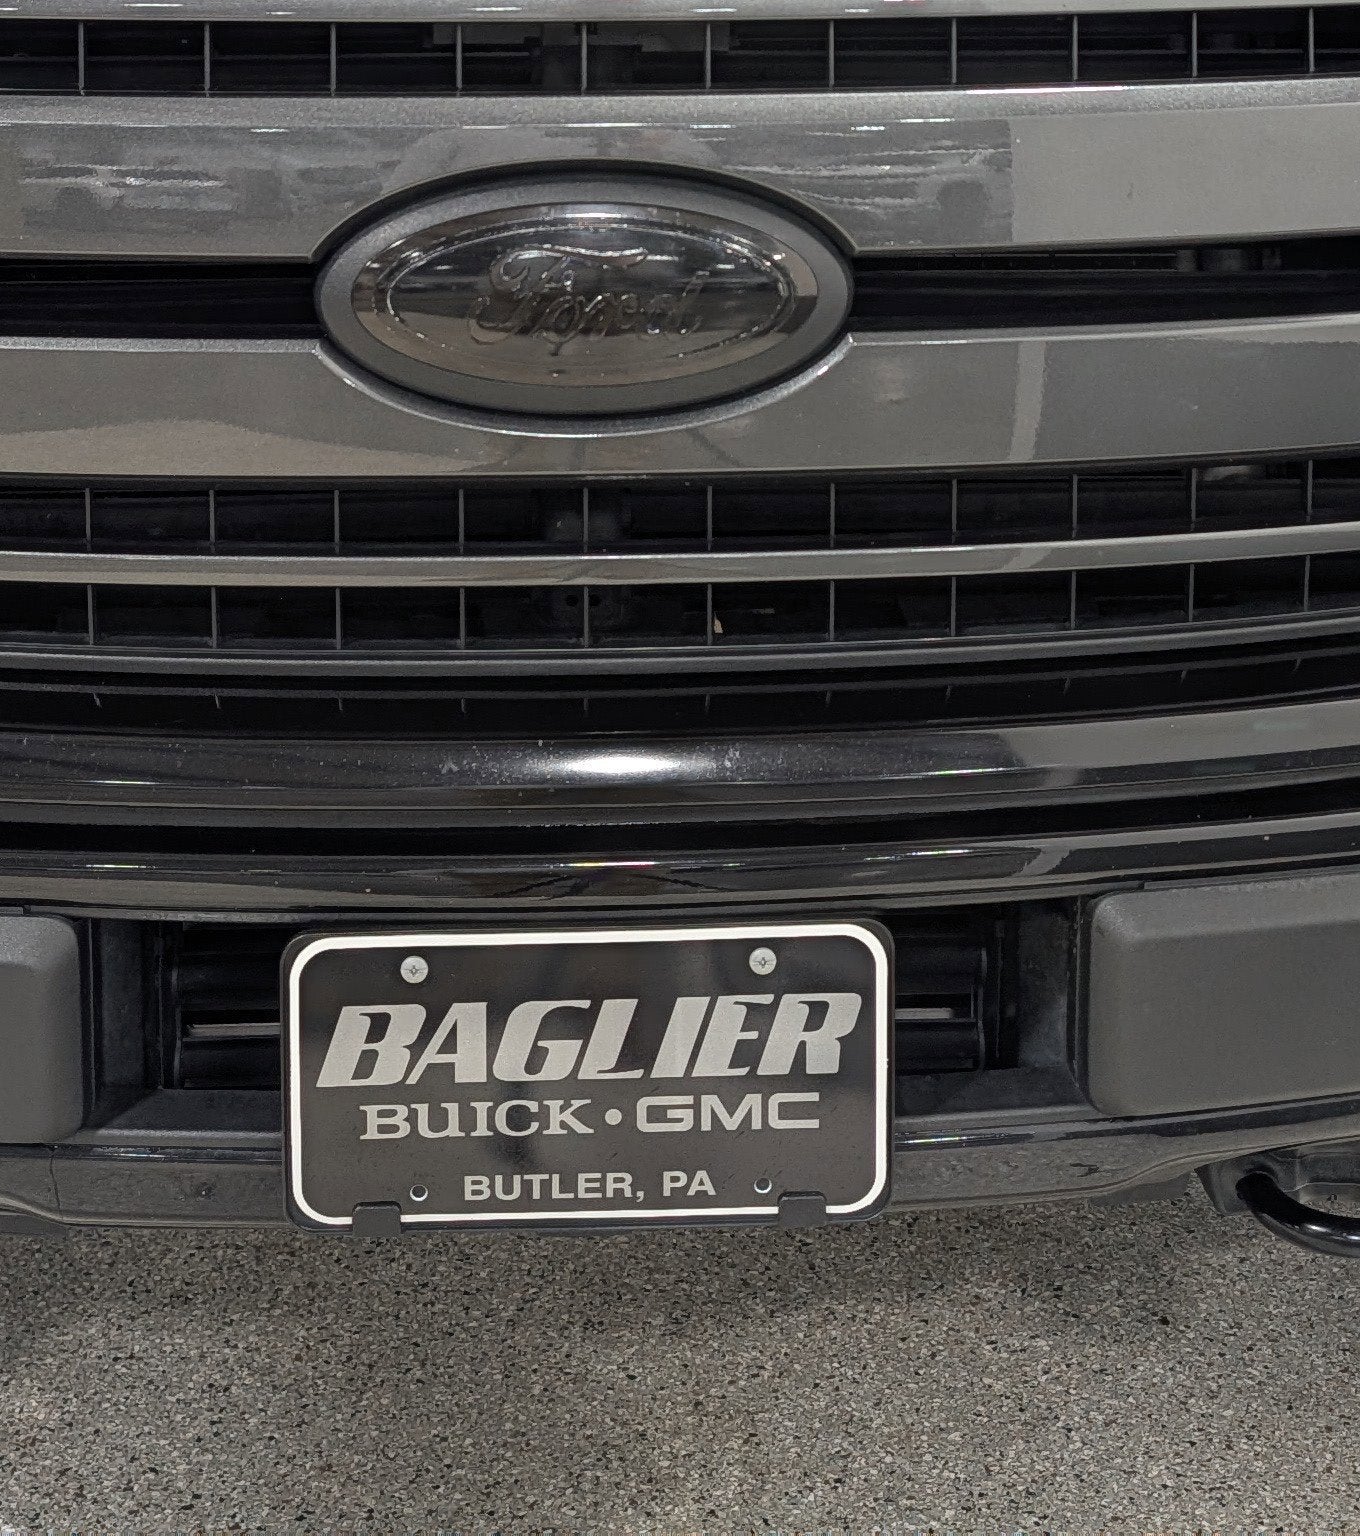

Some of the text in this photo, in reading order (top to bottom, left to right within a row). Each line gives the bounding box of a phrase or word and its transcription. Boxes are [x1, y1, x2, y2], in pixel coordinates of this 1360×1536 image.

[315, 992, 862, 1087] BAGLIER
[463, 1169, 716, 1202] BUTLER, PA
